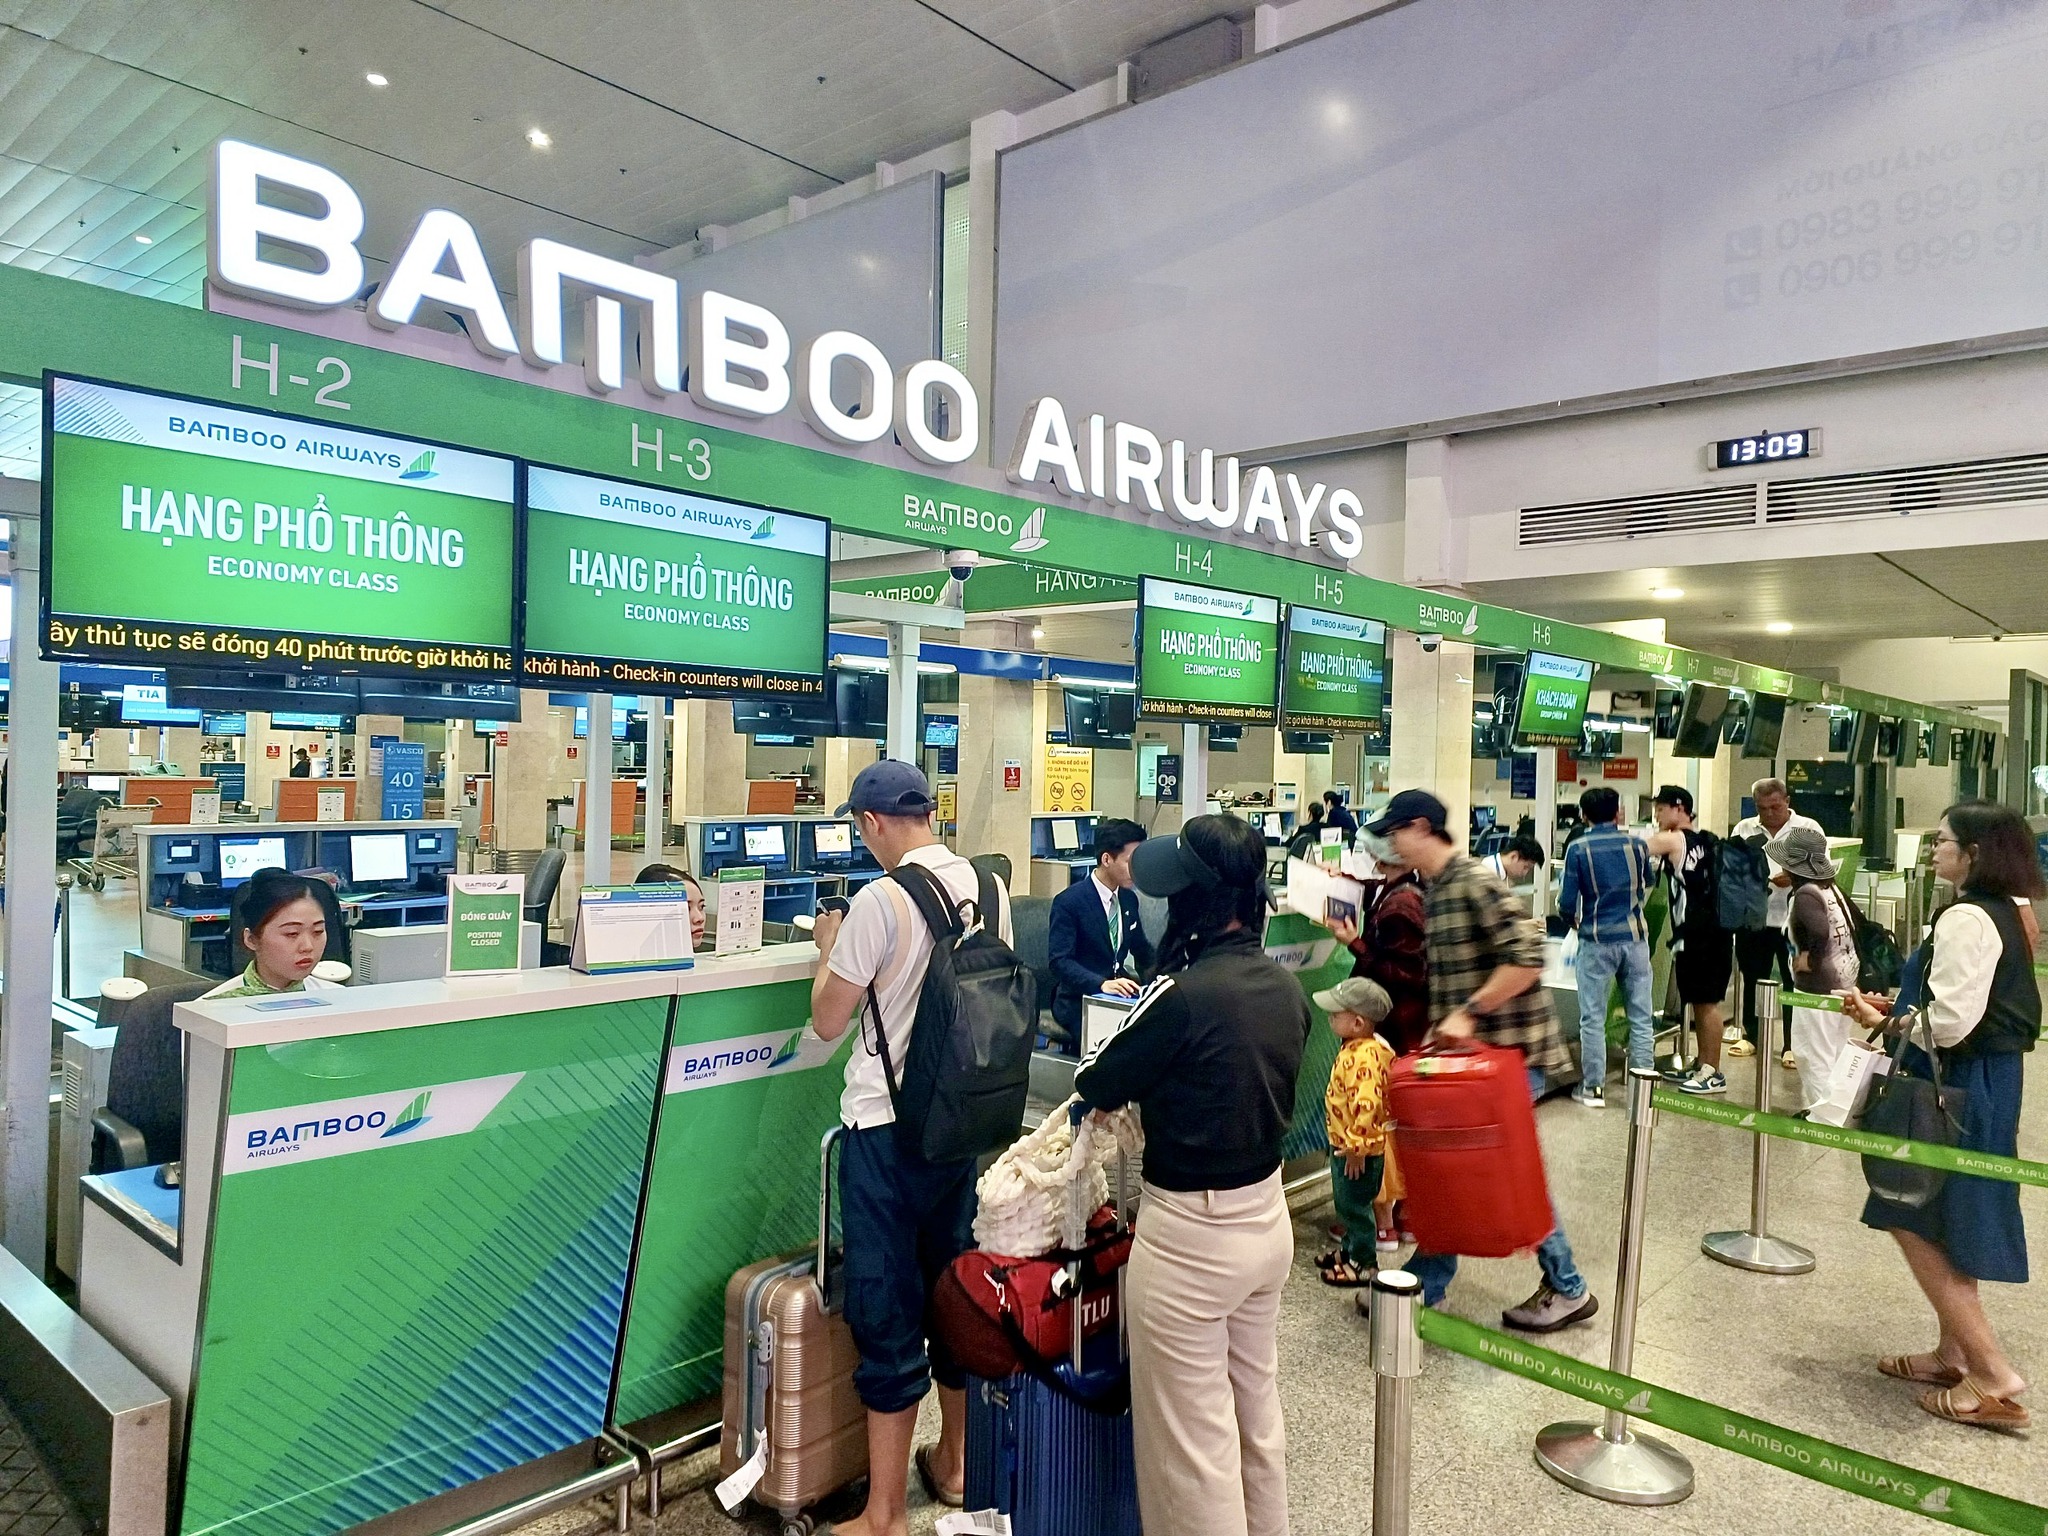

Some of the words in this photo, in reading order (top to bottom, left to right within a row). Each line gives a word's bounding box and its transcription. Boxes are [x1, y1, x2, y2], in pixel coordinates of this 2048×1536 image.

[1774, 198, 1883, 251] 0983
[1777, 248, 1884, 299] 0906
[212, 138, 980, 464] BAMBOO
[1014, 397, 1364, 559] AIRWAYS
[231, 335, 352, 411] H-2
[168, 416, 287, 450] BAMBOO
[295, 438, 402, 469] AIRWAYS
[630, 422, 713, 482] H-3
[1731, 433, 1803, 461] 13:09
[121, 484, 244, 547] HẠNG
[253, 493, 335, 553] PHỔ
[340, 510, 465, 569] THÔNG
[599, 493, 677, 518] BAMBOO
[681, 508, 753, 531] AIRWAYS
[903, 493, 1013, 537] BAMBOO
[904, 519, 948, 536] AIRWAYS
[1174, 541, 1213, 578] H-4
[207, 555, 324, 586] ECONOMY
[328, 569, 400, 594] CLASS
[568, 548, 649, 597] HẠNG
[654, 552, 707, 600] PHỔ
[711, 565, 794, 611] THÔNG
[1174, 591, 1209, 606] BAMBOO
[1211, 598, 1244, 611] AIRWAYS
[1314, 574, 1344, 605] H-5
[624, 603, 701, 626] ECONOMY
[703, 611, 750, 632] CLASS
[1311, 618, 1336, 630] BAMBOO
[1337, 621, 1361, 633] AIRWAYS
[1419, 603, 1464, 624] BAMBOO
[85, 622, 127, 646] thủ
[133, 627, 172, 651] tục
[178, 631, 206, 651] sẽ
[211, 632, 270, 659] đóng
[274, 637, 303, 657] 40
[308, 639, 355, 662] phút
[358, 642, 413, 664] trước
[416, 648, 448, 669] giờ
[450, 647, 489, 669] khởi
[1160, 628, 1195, 661] HẠNG
[1197, 626, 1222, 658] PHỔ
[1223, 632, 1262, 664] THÔNG
[1532, 621, 1551, 646] H-6
[1183, 662, 1219, 678] ECONOMY
[1219, 666, 1242, 679] CLASS
[1300, 650, 1326, 679] HẠNG
[1326, 648, 1345, 676] PHỔ
[1345, 653, 1373, 679] THÔNG
[1638, 650, 1665, 666] BAMBOO
[1687, 657, 1700, 674] H-7
[523, 656, 558, 676] khởi
[561, 659, 600, 678] hành
[612, 663, 676, 684] Check-in
[679, 669, 738, 688] counters
[742, 674, 763, 690] will
[766, 676, 799, 692] close
[802, 679, 813, 693] in
[815, 680, 823, 693] 4
[1316, 680, 1341, 693] ECONOMY
[1341, 682, 1358, 694] CLASS
[137, 689, 160, 699] TIA
[1188, 703, 1217, 716] Check-in
[1216, 705, 1245, 717] counters
[1245, 707, 1256, 718] will
[1256, 708, 1272, 719] close
[389, 772, 414, 788] 40
[390, 803, 413, 819] 15
[460, 911, 487, 921] ĐÓNG
[467, 931, 502, 939] POSITION
[470, 938, 500, 946] CLOSED
[684, 1045, 773, 1074] BAMBOO
[684, 1070, 718, 1082] AIRWAYS
[1652, 1094, 1695, 1111] BAMBOO
[1697, 1105, 1741, 1122] AIRWAYS
[246, 1110, 387, 1149] BAMBOO
[1793, 1126, 1841, 1142] BAMBOO
[1843, 1136, 1894, 1152] AIRWAYS
[247, 1144, 300, 1159] AIRWAYS
[1956, 1157, 2013, 1174] BAMBOO
[1081, 1296, 1111, 1328] TLU
[1478, 1338, 1546, 1374] BAMBOO
[1551, 1365, 1625, 1401] AIRWAYS
[1723, 1423, 1811, 1465] BAMBOO
[1819, 1456, 1917, 1498] AIRWAYS
